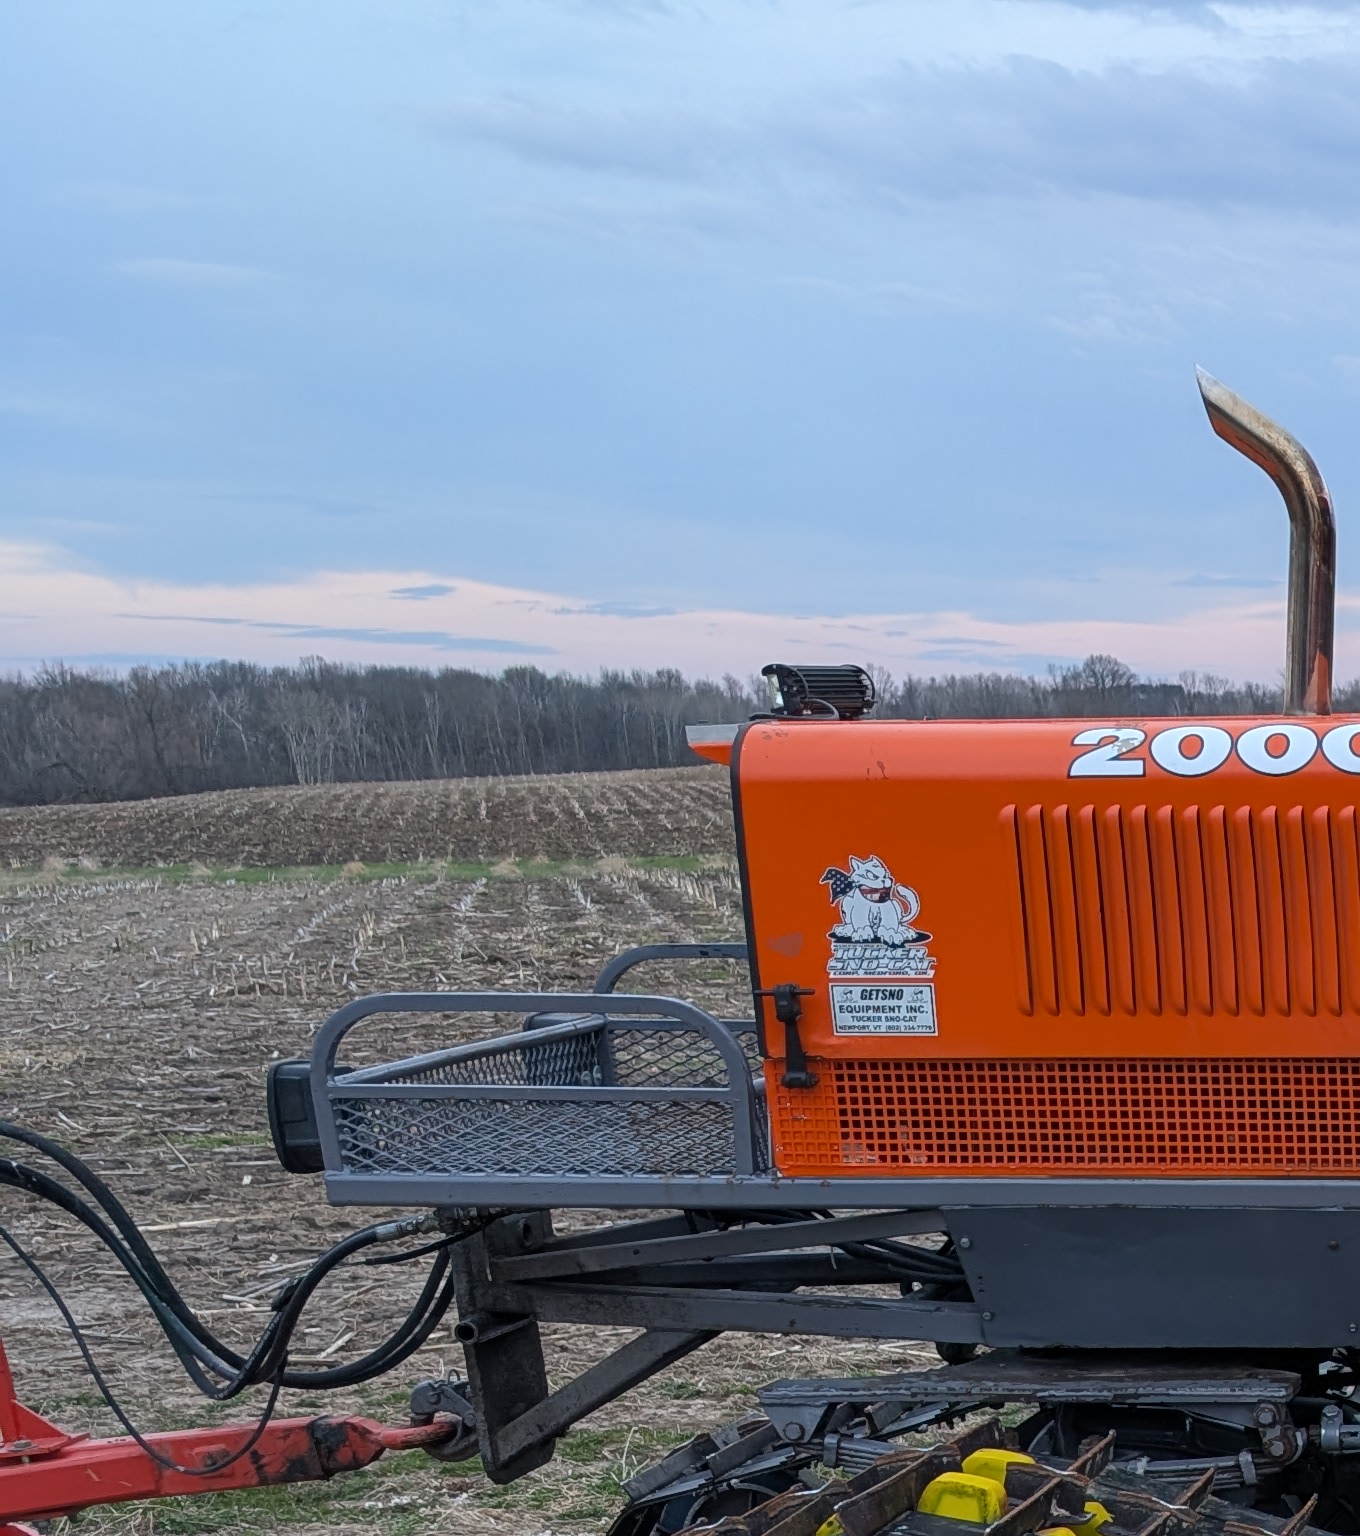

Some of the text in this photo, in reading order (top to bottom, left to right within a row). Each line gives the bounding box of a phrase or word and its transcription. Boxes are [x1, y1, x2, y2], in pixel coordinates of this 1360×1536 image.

[834, 947, 927, 959] TUCKER
[828, 957, 935, 971] SNO-CAT
[860, 988, 904, 1001] GETSNO
[839, 1005, 902, 1014] EQUIPMENT
